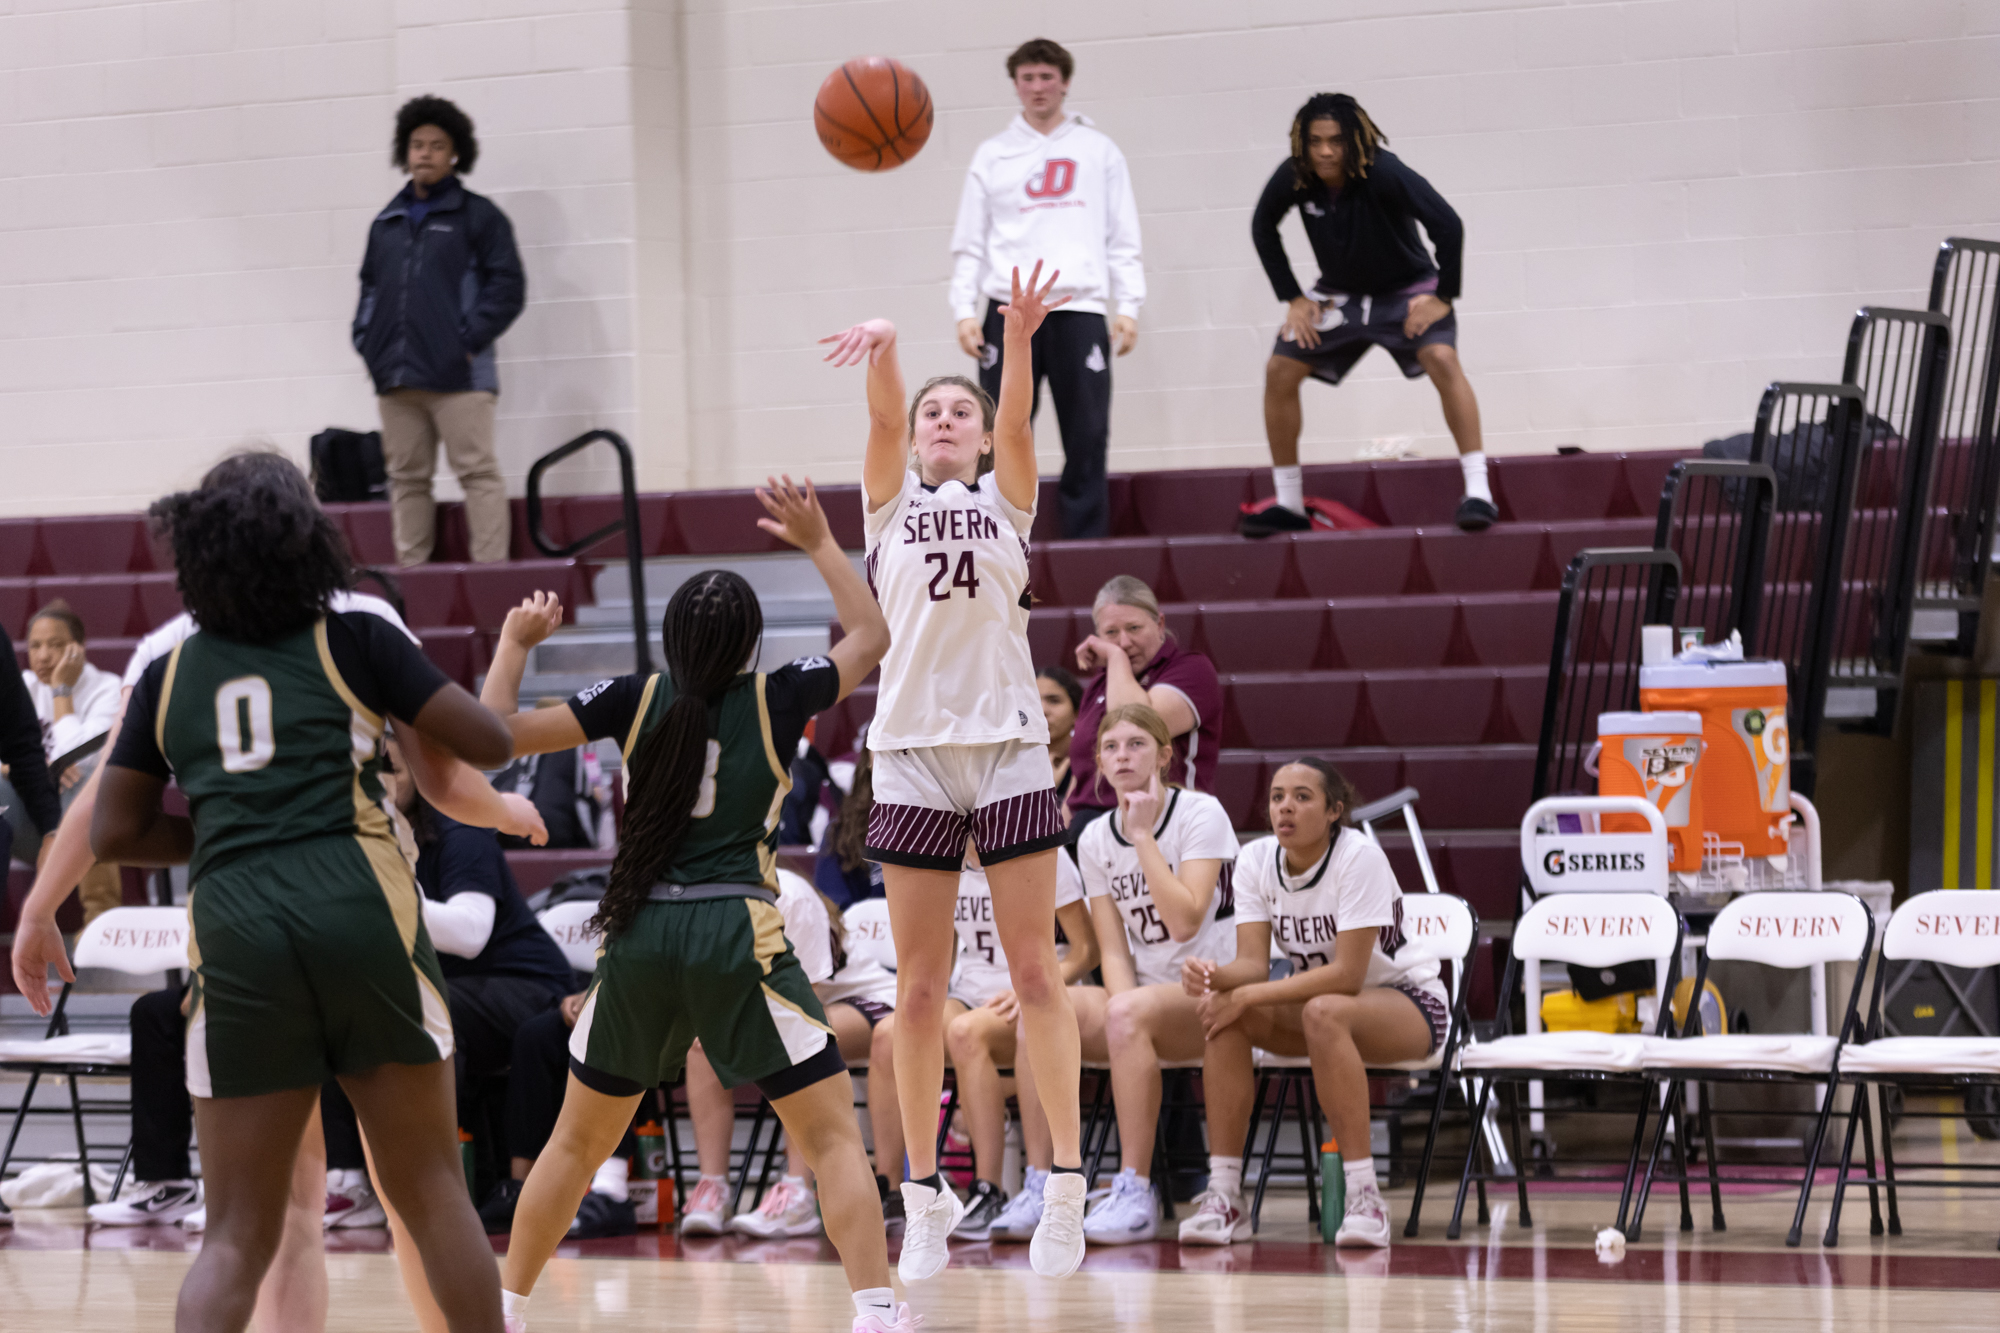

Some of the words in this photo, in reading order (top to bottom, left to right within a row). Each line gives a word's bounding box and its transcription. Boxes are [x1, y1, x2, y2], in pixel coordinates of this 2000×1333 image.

[904, 510, 998, 544] SEVERN
[925, 551, 979, 601] 24
[215, 674, 276, 774] 0
[1569, 853, 1645, 872] SERIES
[100, 927, 184, 948] SEVERN
[1131, 904, 1170, 944] 25
[1545, 915, 1654, 937] SEVERN
[1738, 915, 1844, 938] SEVERN
[976, 931, 994, 964] 5
